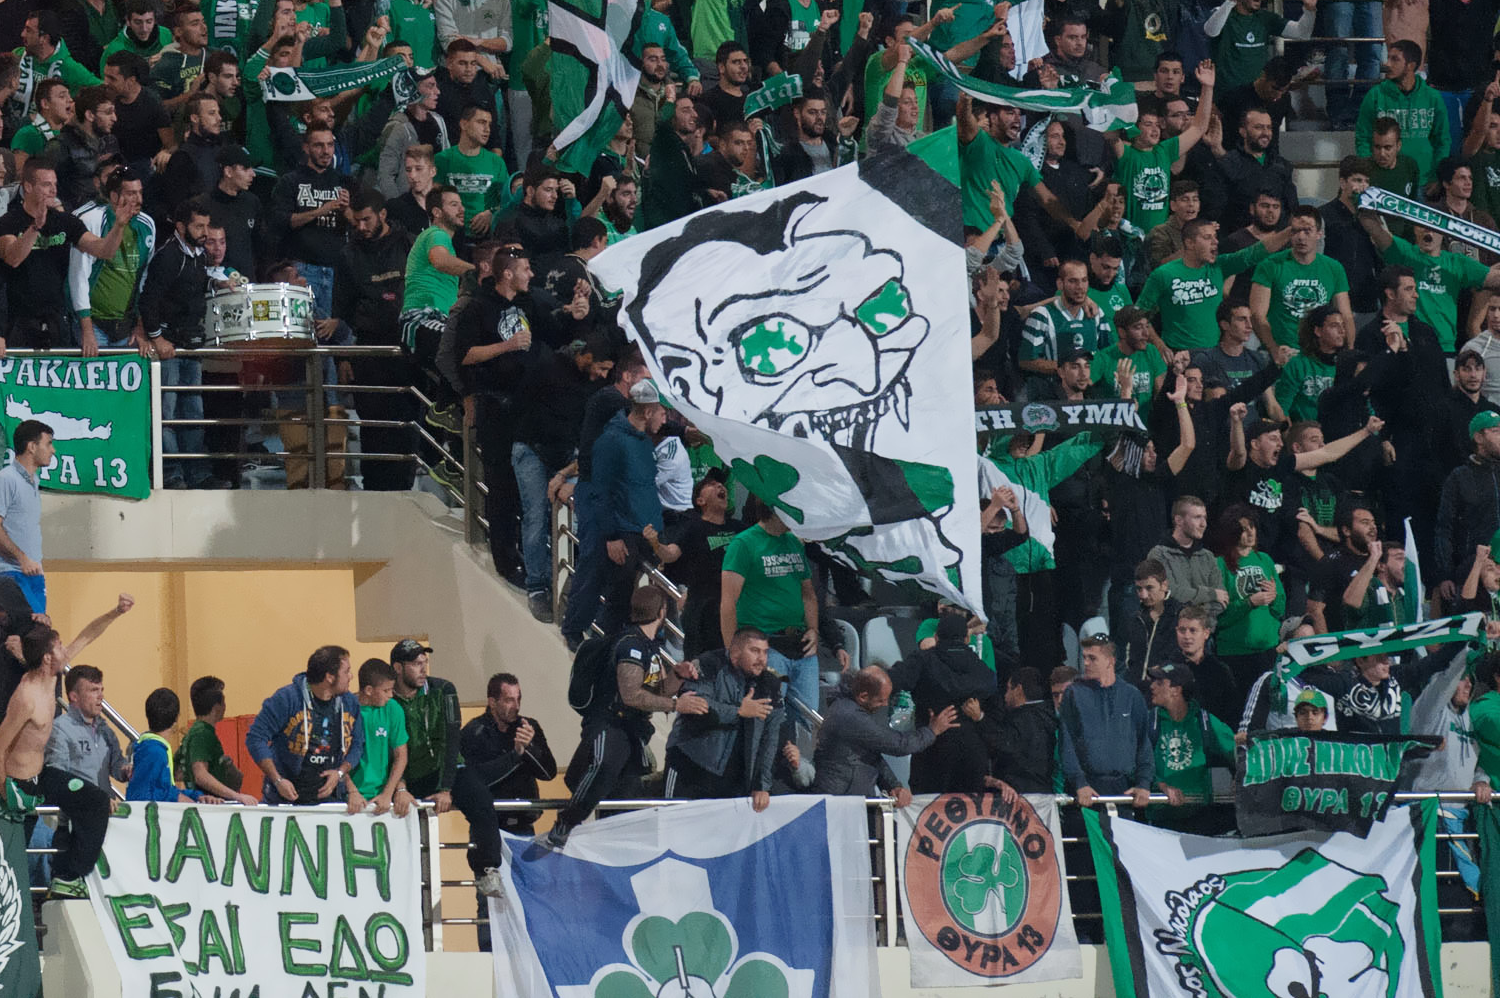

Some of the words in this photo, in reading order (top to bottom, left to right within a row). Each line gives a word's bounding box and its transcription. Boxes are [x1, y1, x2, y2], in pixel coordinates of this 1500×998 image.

[1382, 195, 1442, 225] GREEN
[93, 457, 129, 489] 13
[1281, 785, 1349, 815] ΘΥΡΑ
[916, 792, 1046, 862] ΡΕΘΥΜΝΟ
[98, 802, 391, 902] ΙΑΝΝΗ
[937, 926, 1020, 972] ΘΥΡΑ
[1016, 924, 1045, 955] 13
